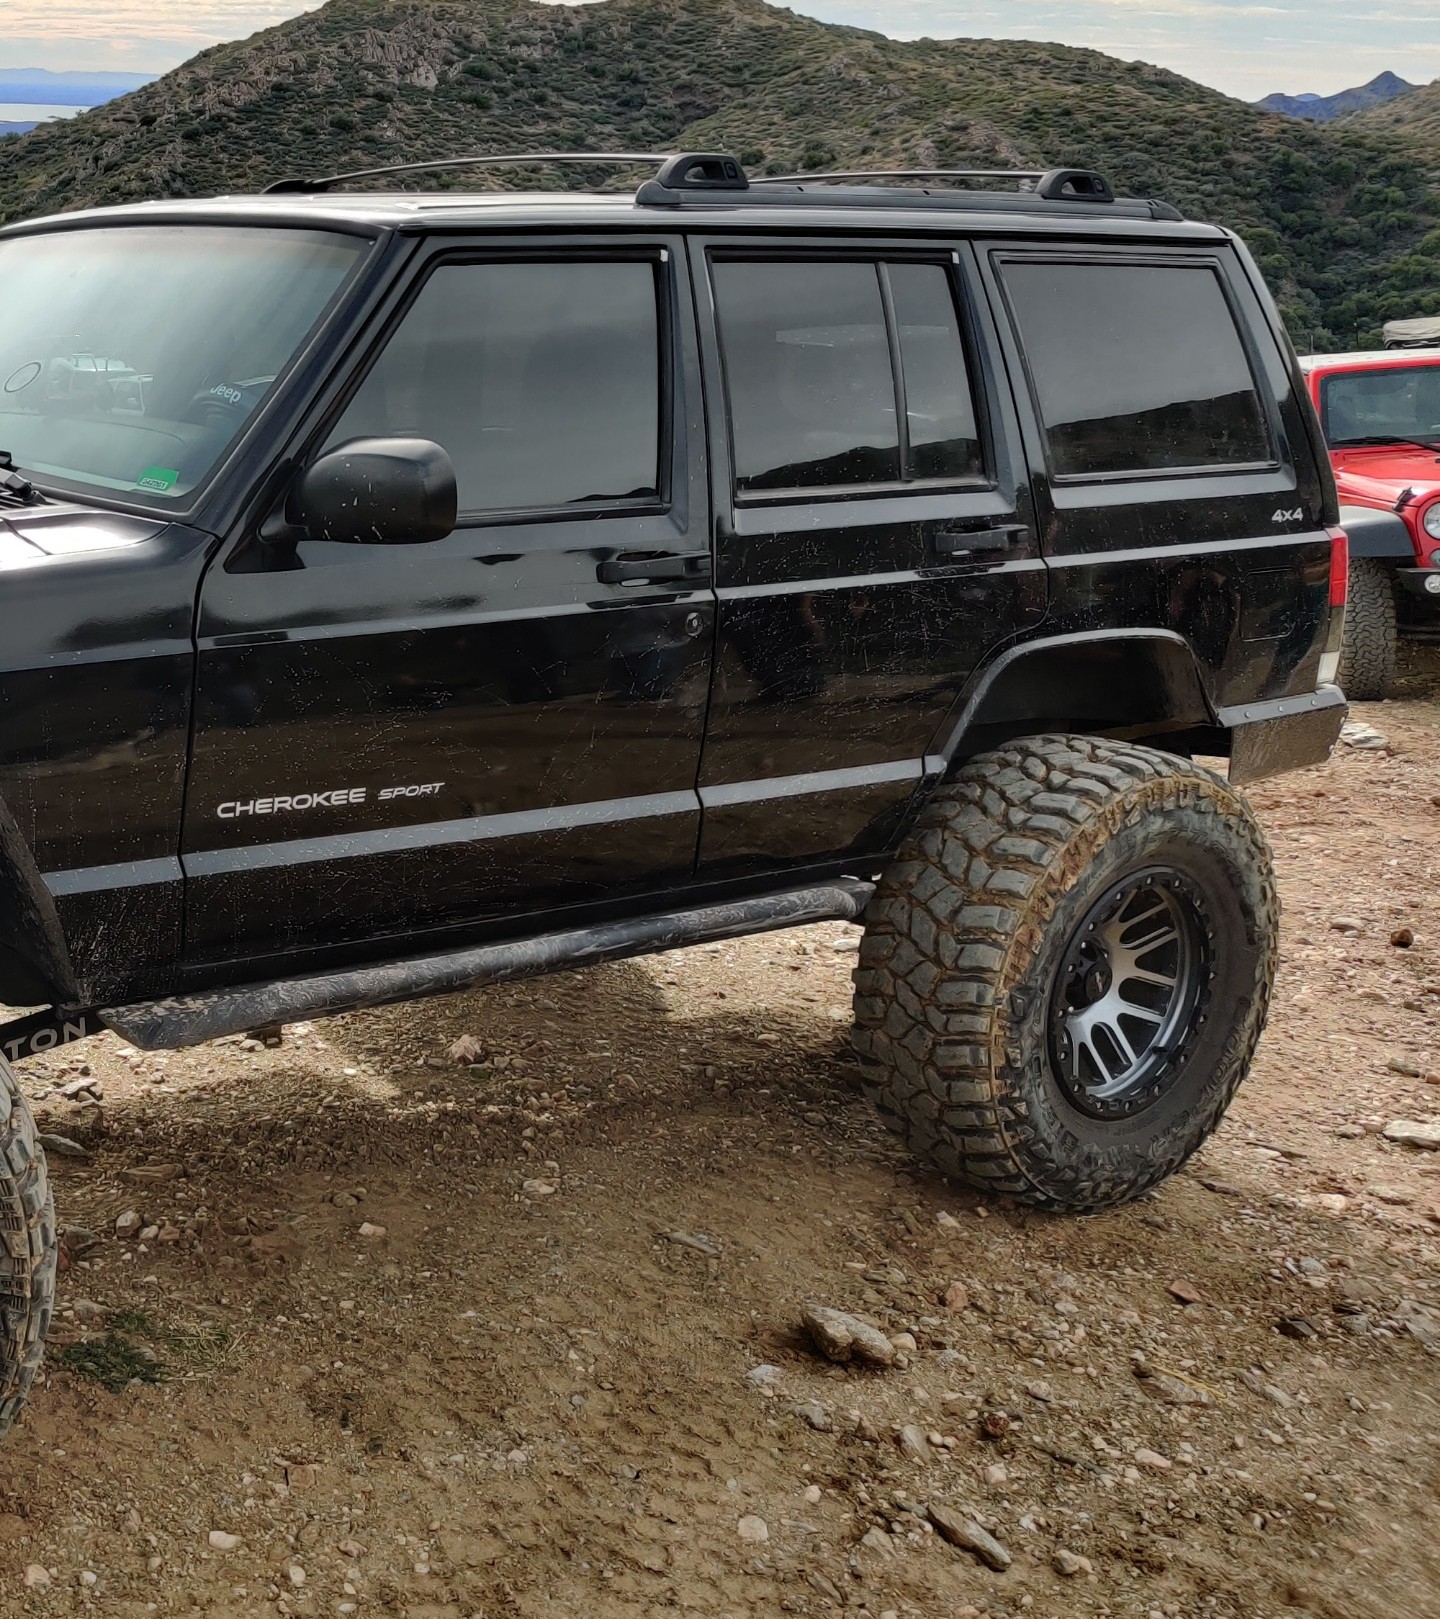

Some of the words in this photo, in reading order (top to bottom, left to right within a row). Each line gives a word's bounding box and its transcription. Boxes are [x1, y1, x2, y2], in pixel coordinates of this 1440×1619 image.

[210, 383, 242, 403] Jeep
[1271, 507, 1304, 523] 4x4
[216, 787, 367, 819] CHEROKEE
[377, 782, 446, 800] SPORT
[3, 1016, 87, 1060] TON
